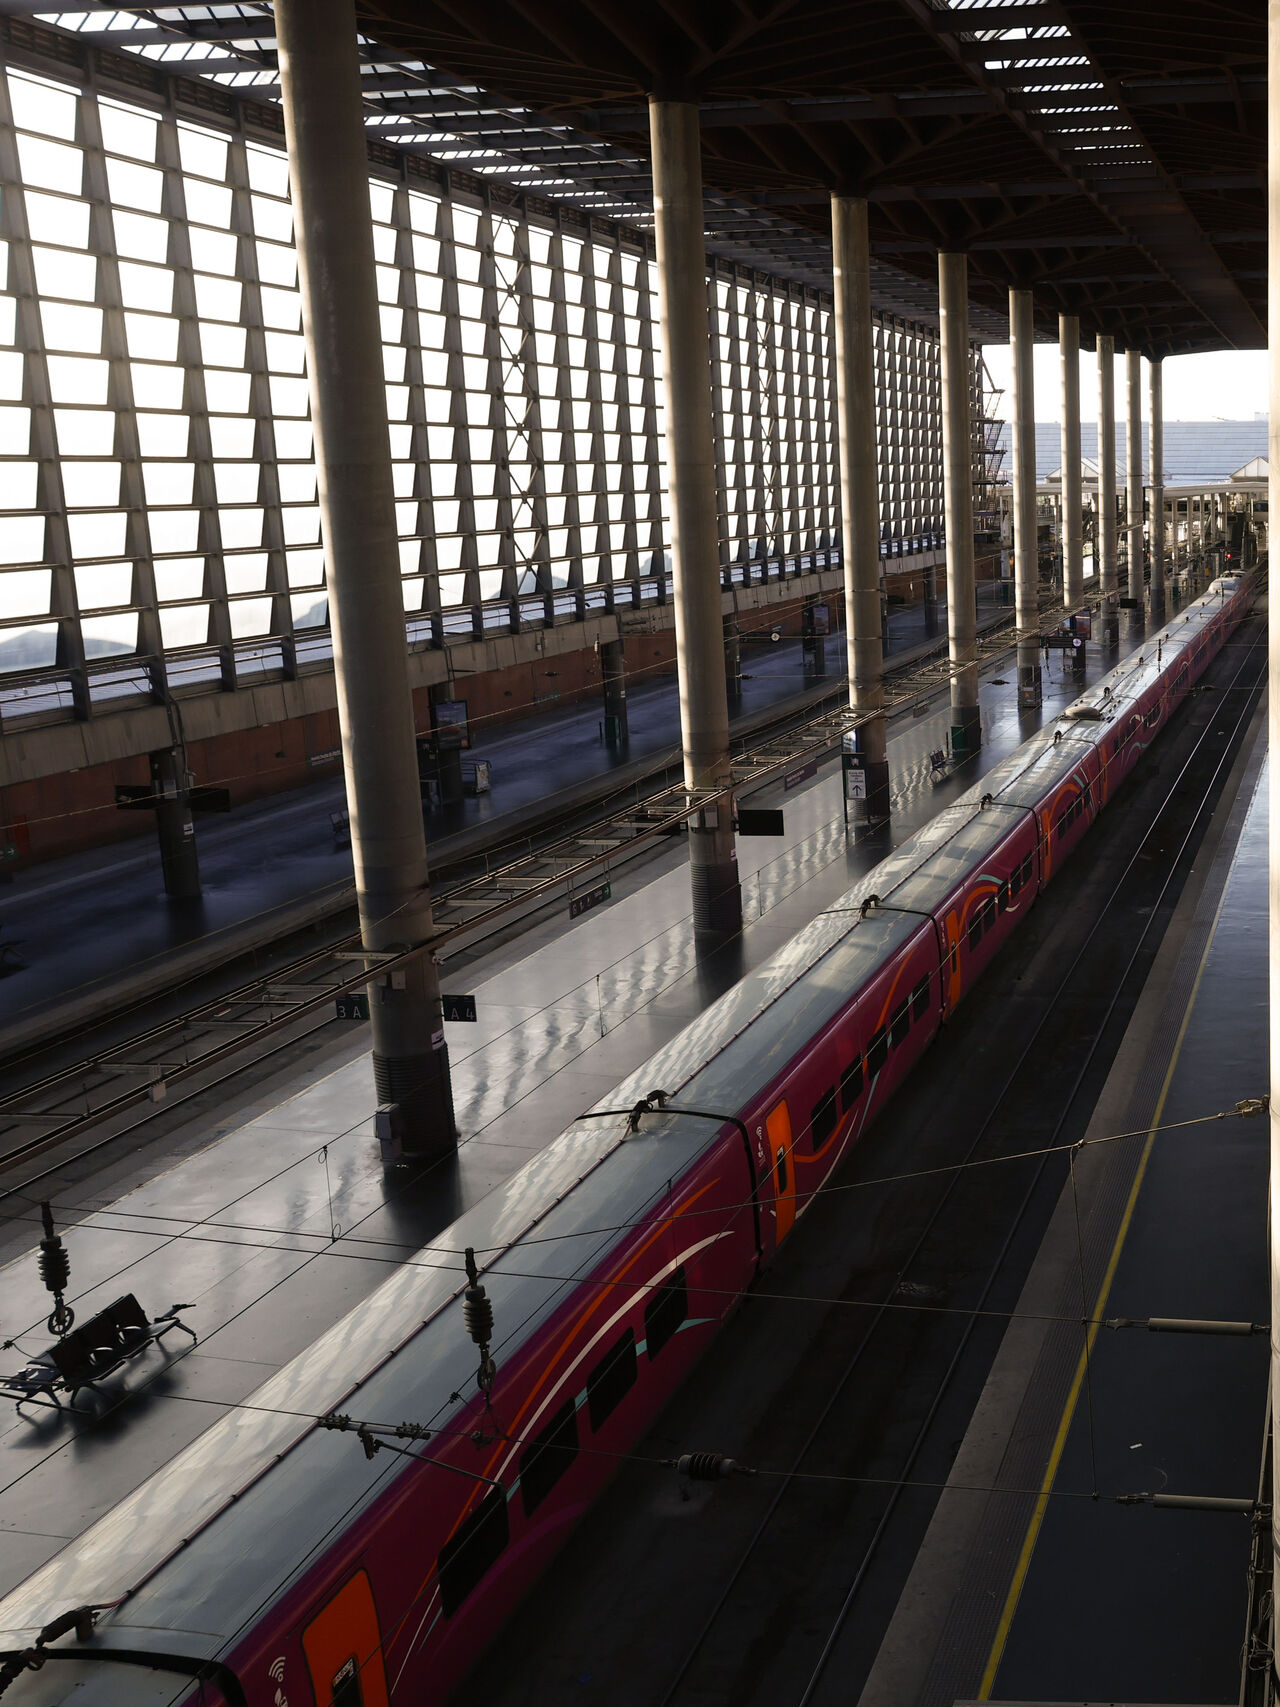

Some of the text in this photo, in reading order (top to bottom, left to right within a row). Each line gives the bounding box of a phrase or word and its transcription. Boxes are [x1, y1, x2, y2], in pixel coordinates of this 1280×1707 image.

[338, 1006, 361, 1018] 3 A
[451, 1008, 475, 1020] A 4
